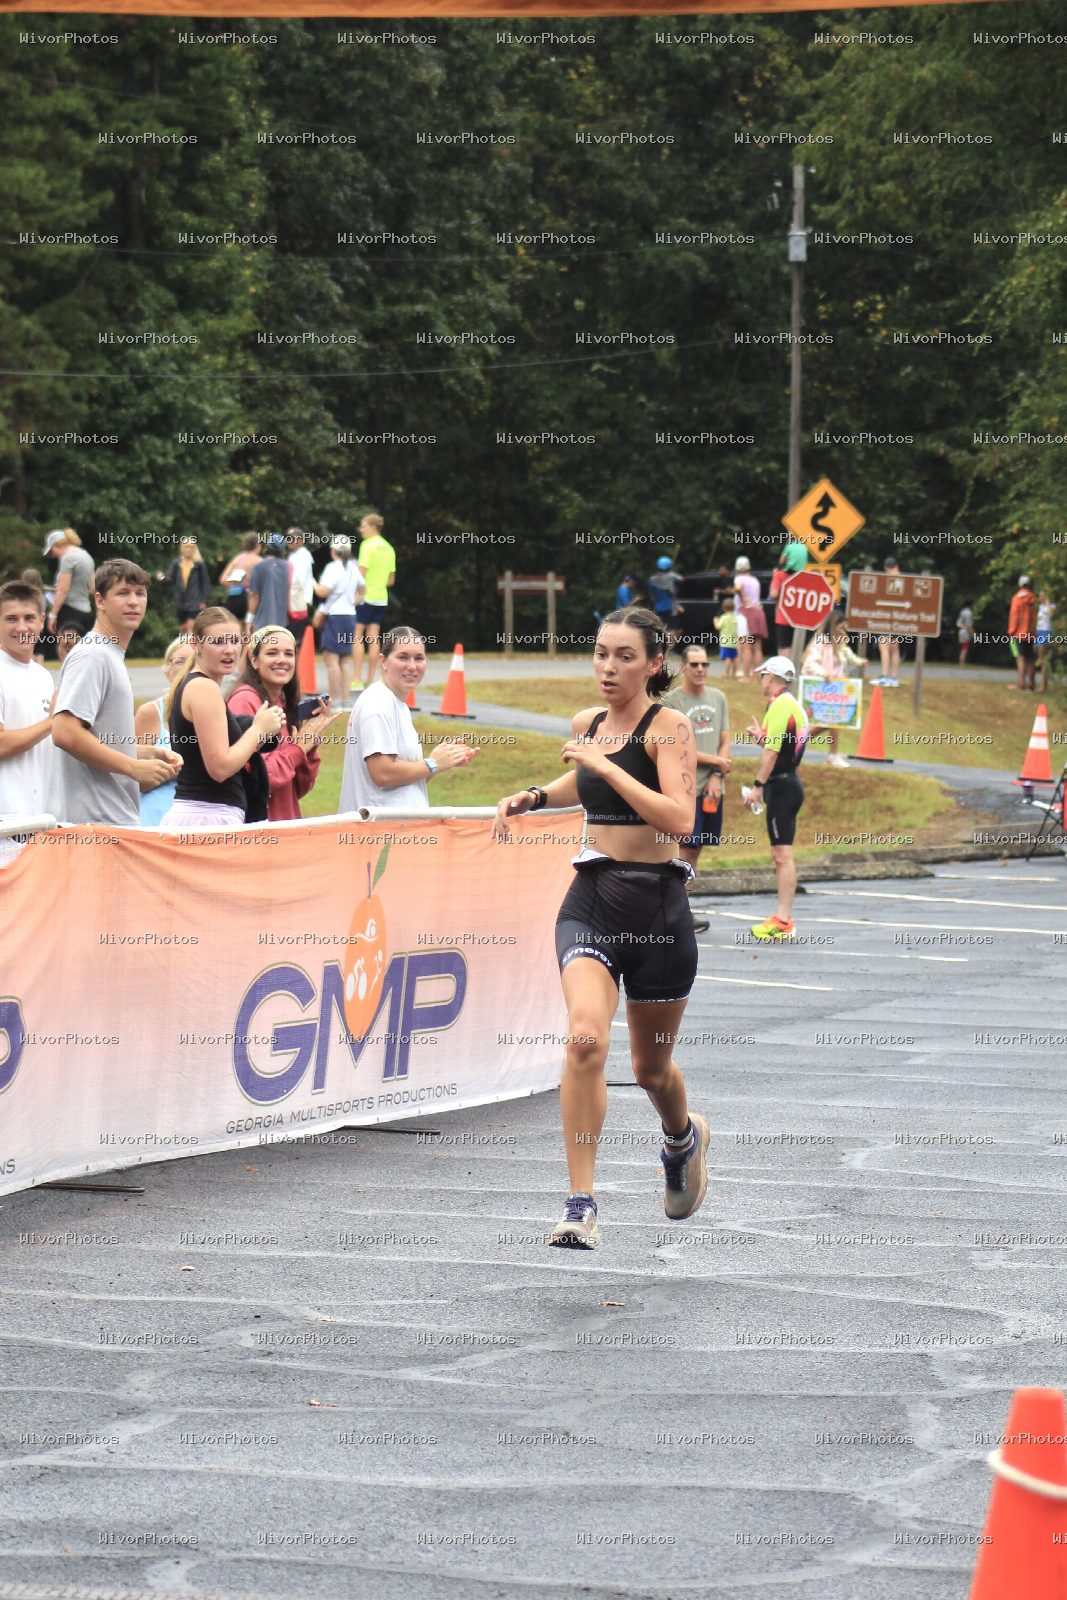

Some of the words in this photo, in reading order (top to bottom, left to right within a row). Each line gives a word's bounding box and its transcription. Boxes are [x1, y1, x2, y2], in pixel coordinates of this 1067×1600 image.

[784, 586, 831, 613] STOP
[562, 946, 613, 967] synergy
[231, 946, 468, 1107] GMP
[226, 1114, 284, 1134] GEORGIA
[290, 1098, 375, 1124] MULTISPORTS
[378, 1083, 458, 1108] PRODUCTIONS
